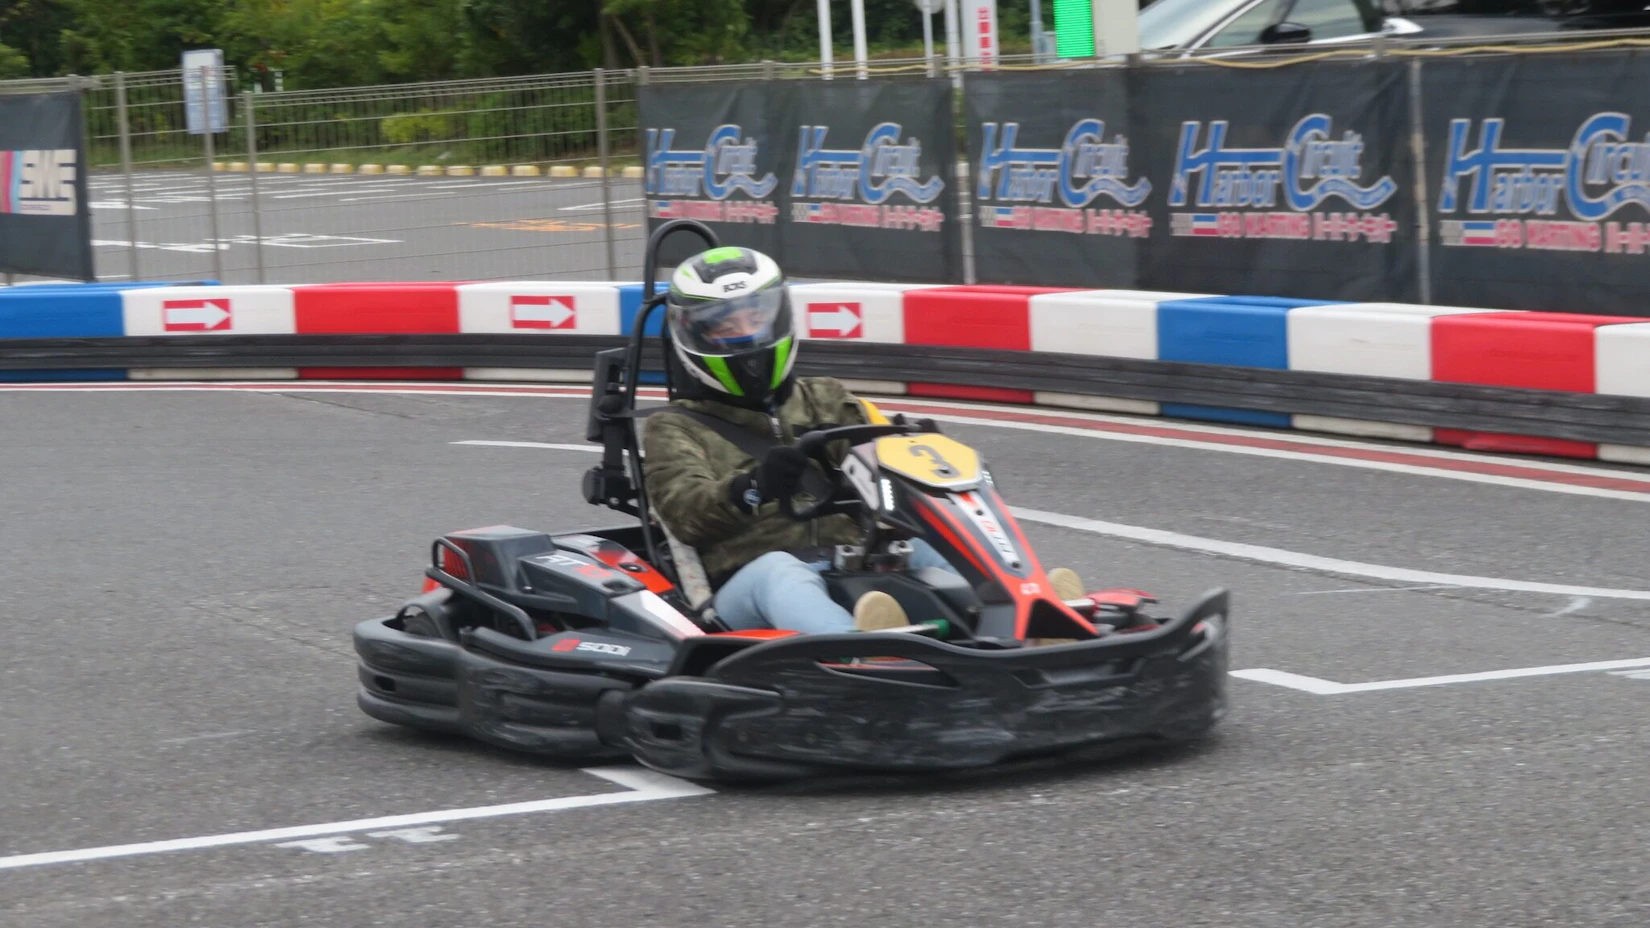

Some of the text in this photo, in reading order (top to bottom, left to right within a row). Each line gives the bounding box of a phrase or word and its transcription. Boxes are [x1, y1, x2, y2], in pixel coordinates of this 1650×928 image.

[1167, 120, 1284, 207] Harbor
[1437, 118, 1568, 214] Harbor
[908, 445, 960, 478] 3
